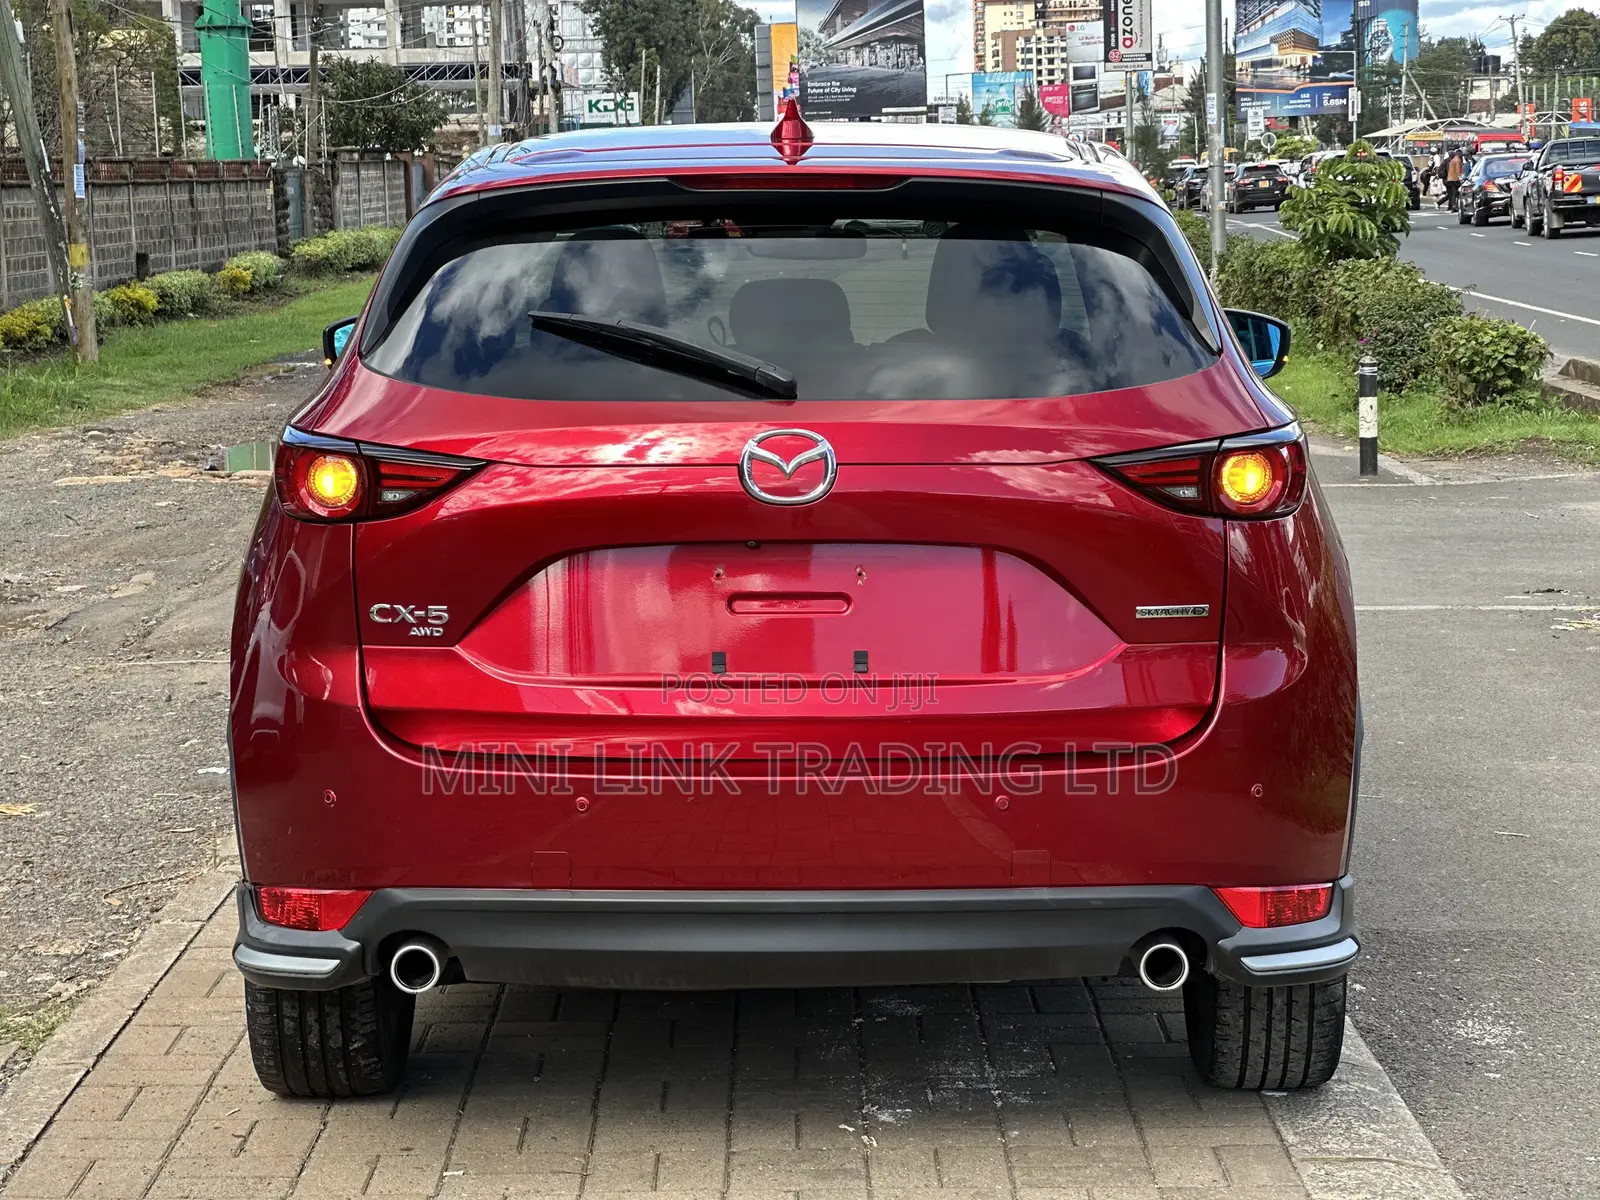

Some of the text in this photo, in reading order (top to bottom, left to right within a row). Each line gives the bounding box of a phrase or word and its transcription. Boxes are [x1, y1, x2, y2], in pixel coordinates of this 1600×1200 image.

[588, 96, 635, 113] KDG
[369, 603, 449, 625] CX-5
[408, 627, 444, 637] AWD
